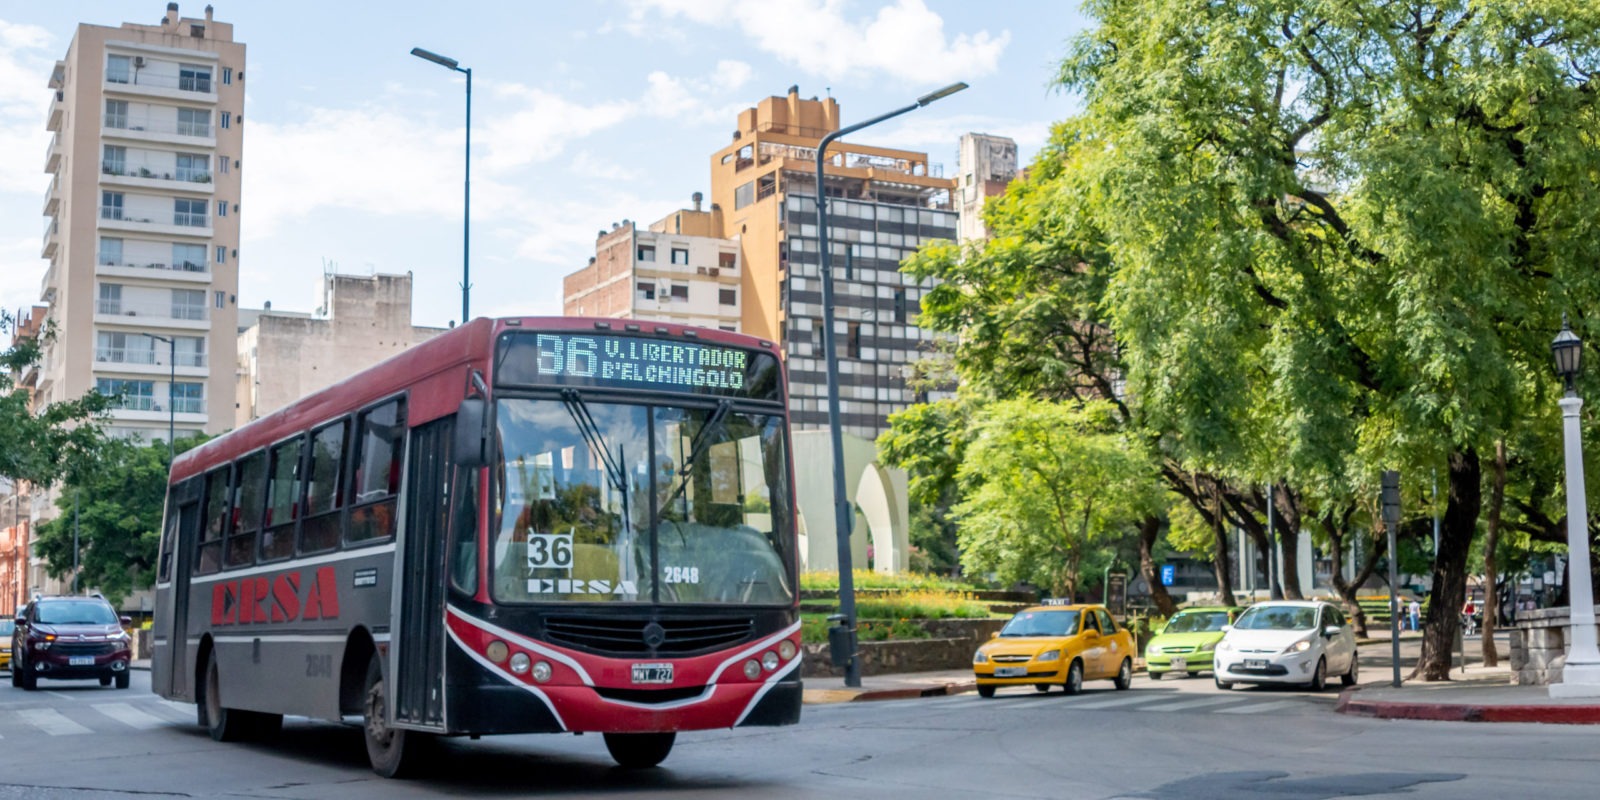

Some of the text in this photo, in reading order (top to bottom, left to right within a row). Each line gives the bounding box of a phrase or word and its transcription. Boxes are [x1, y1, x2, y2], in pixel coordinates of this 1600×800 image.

[537, 334, 598, 377] 36
[630, 342, 745, 368] LIBERTADOR
[528, 536, 572, 566] 36
[664, 566, 699, 584] 2648
[210, 566, 340, 627] ERSA
[527, 579, 639, 595] ERSA
[1048, 598, 1065, 606] TAXI
[655, 668, 673, 681] 727
